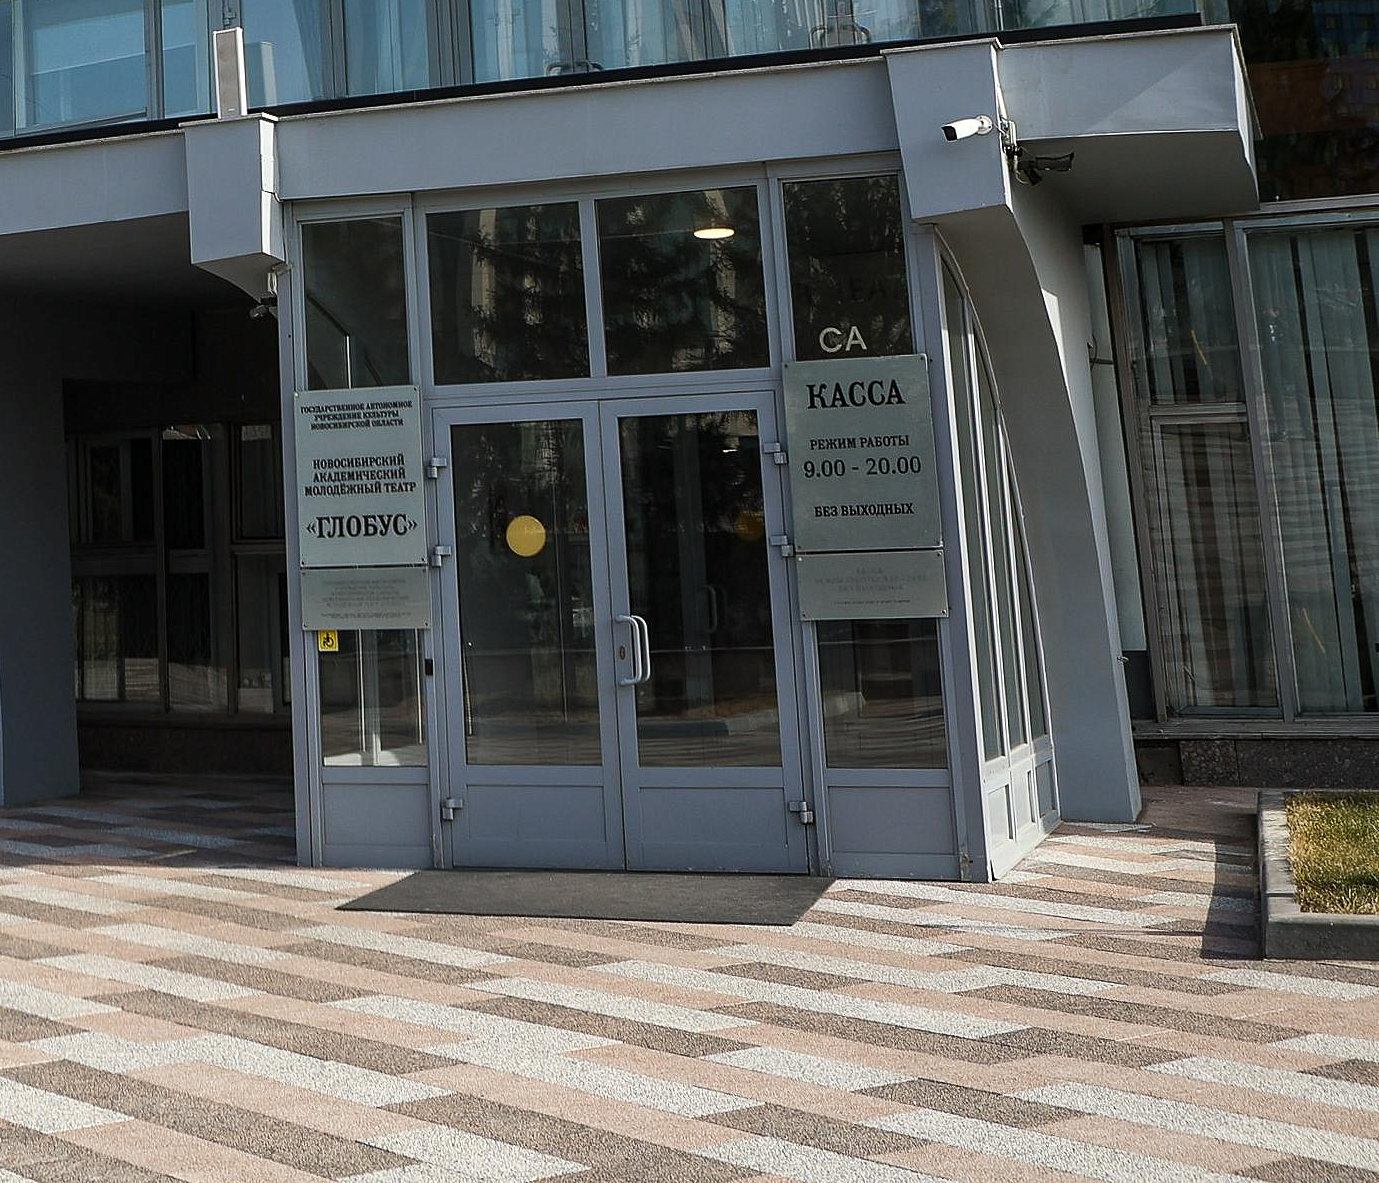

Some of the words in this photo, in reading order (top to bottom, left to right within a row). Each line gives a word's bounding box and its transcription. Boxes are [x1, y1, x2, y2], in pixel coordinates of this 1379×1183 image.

[806, 379, 906, 409] КАССА
[372, 418, 404, 428] ОБЛАСТИ
[810, 437, 857, 450] РЕЖИМ
[860, 435, 910, 448] РАБОТЫ
[312, 452, 405, 470] НОВОСИБИРСКИЙ
[803, 459, 846, 478] 9.00
[866, 456, 922, 476] 20.00
[313, 467, 406, 484] АКАДЕМИЧЕСКИЙ
[304, 481, 381, 497] МОЛОДЁЖНЫЙ
[383, 481, 417, 494] ТЕАТР
[814, 505, 838, 517] БЕЗ
[841, 503, 915, 518] ВЫХОДНЫХ
[306, 513, 418, 539] «ГЛОБУС»
